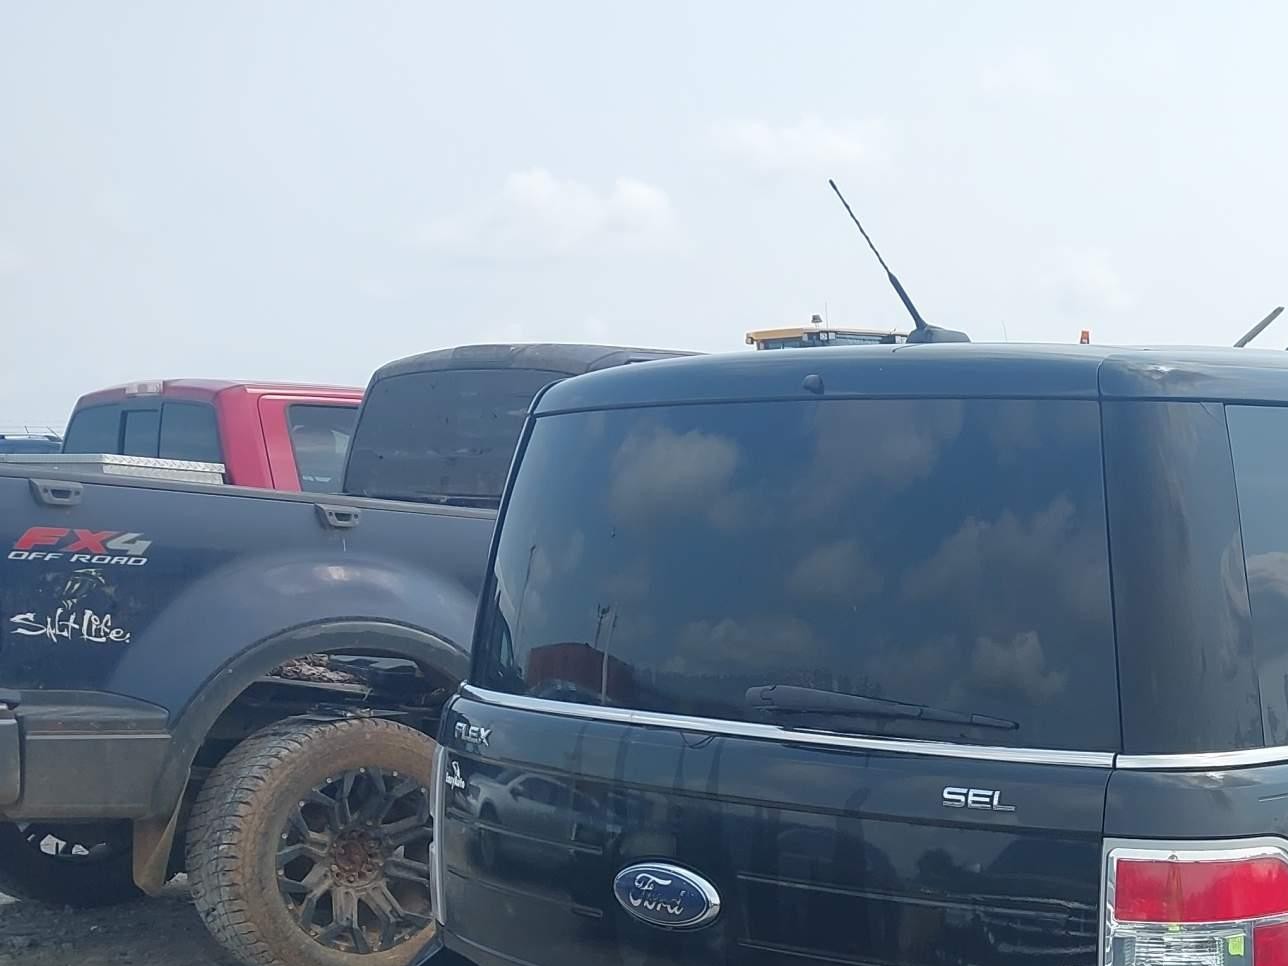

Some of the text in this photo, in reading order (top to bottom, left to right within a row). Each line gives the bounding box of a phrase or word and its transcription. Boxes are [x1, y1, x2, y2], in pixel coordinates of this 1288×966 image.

[13, 526, 152, 555] FX4
[8, 551, 148, 566] OFF ROAD
[455, 721, 492, 747] FLEX
[942, 786, 1016, 811] SEL
[629, 873, 685, 915] Ford
